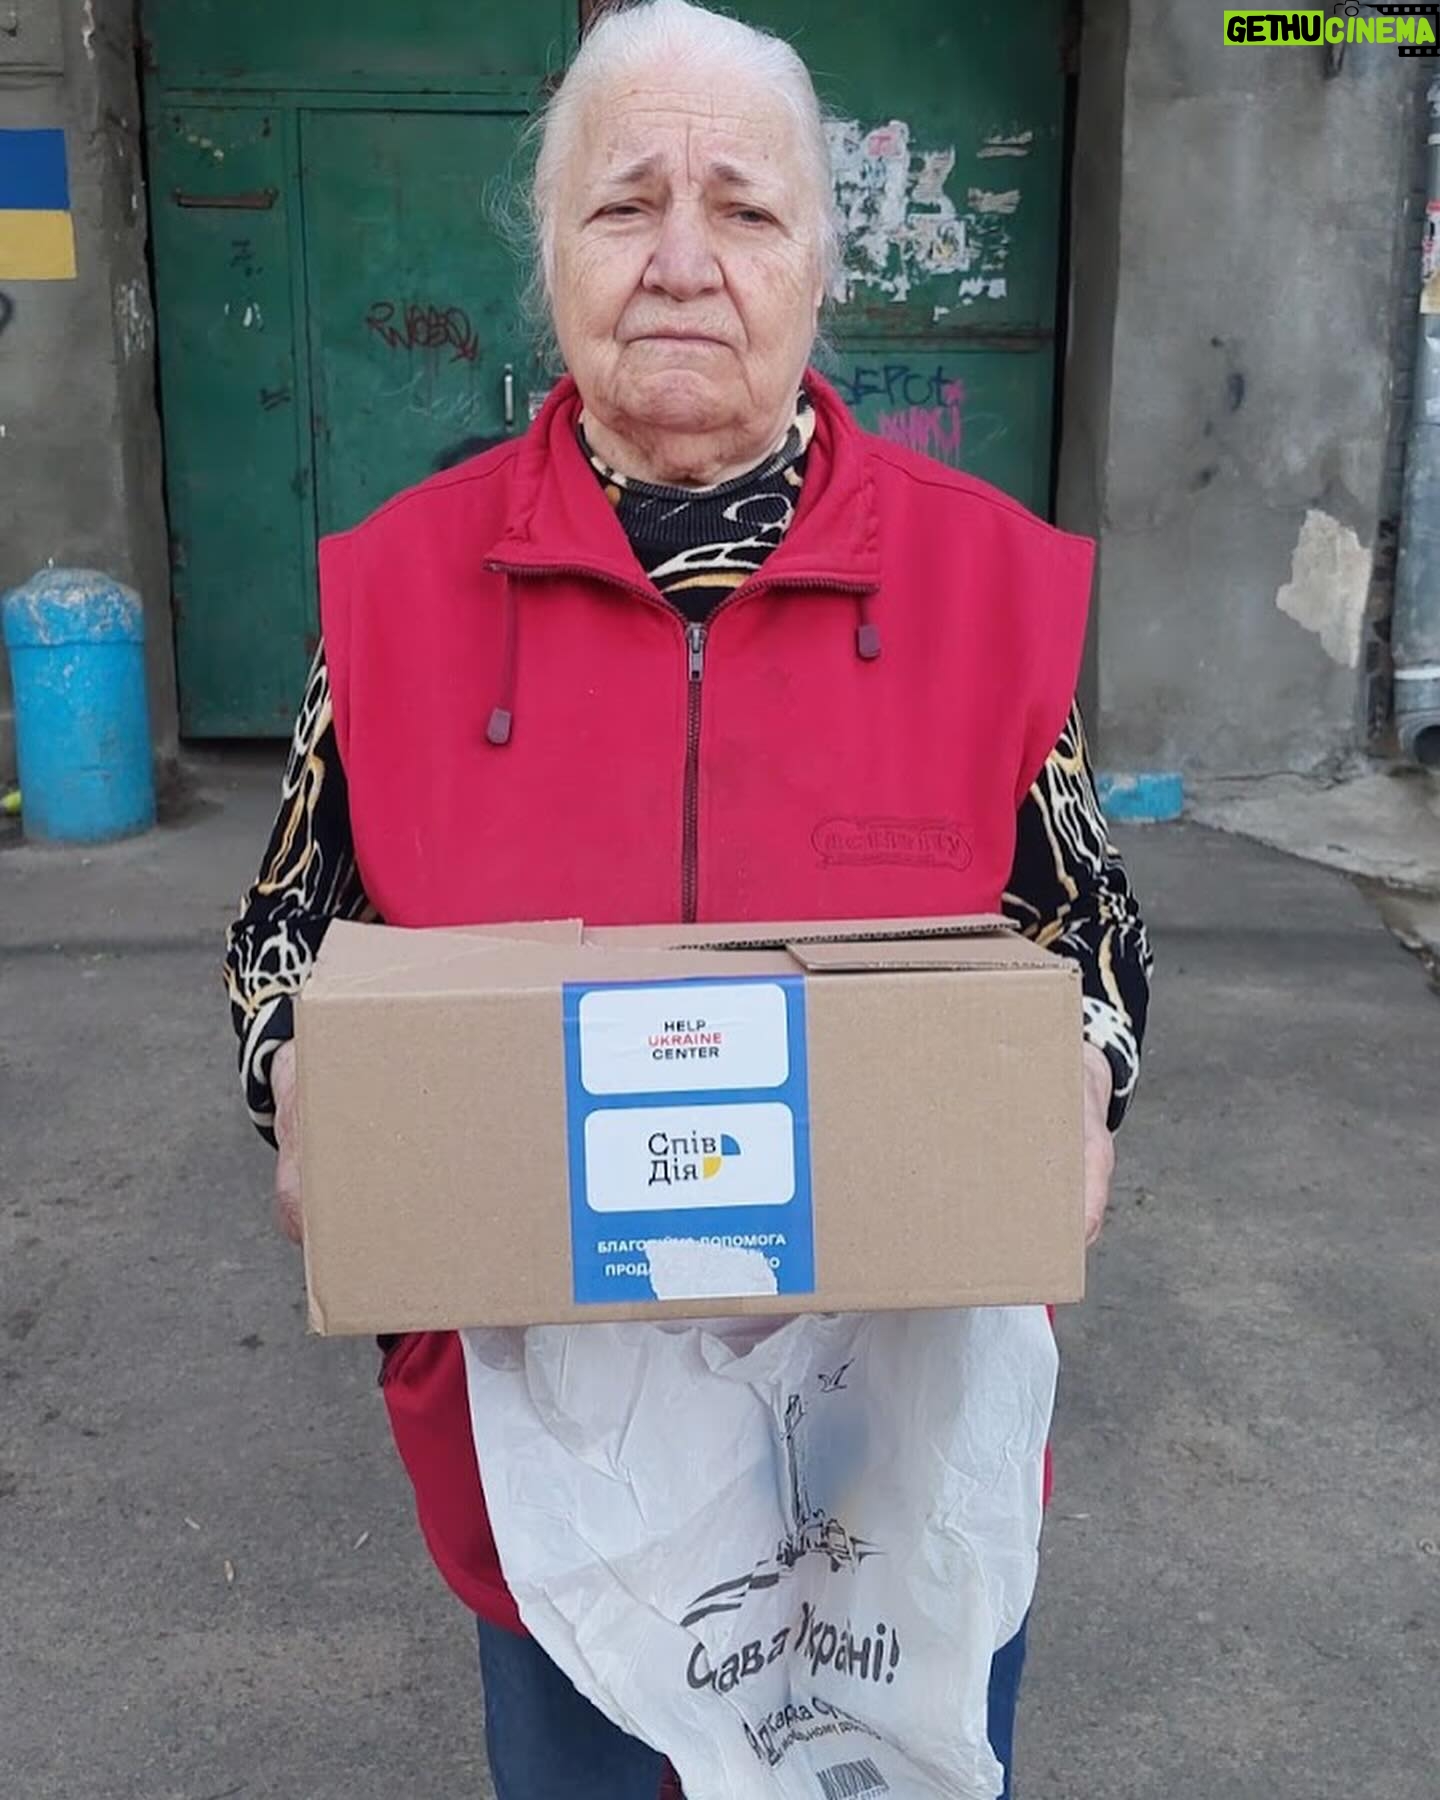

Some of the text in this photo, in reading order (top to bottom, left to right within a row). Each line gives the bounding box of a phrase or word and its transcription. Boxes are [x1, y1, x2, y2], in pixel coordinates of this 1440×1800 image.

[664, 1020, 706, 1032] HELP
[648, 1032, 722, 1047] UKRAINE
[652, 1046, 720, 1060] CENTER
[648, 1130, 716, 1156] Спів
[648, 1157, 698, 1186] Дія
[686, 1627, 792, 1693] Сава
